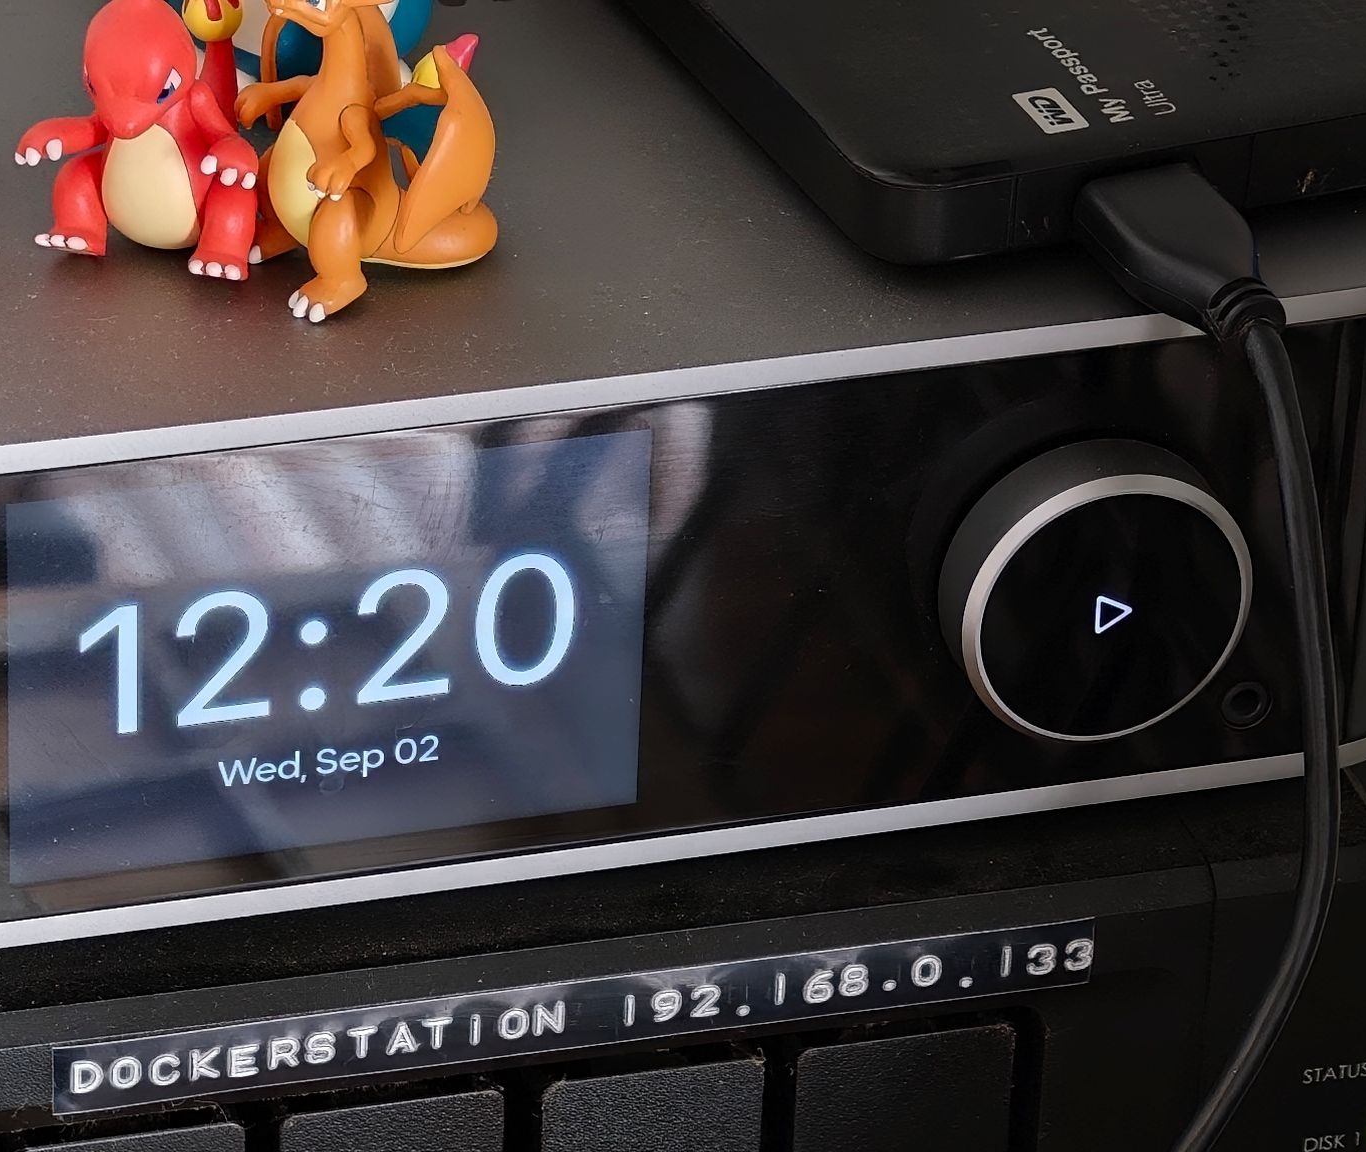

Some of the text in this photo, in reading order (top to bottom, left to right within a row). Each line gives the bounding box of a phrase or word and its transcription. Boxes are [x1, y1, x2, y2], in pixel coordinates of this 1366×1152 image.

[1027, 27, 1134, 123] My Passport
[1134, 79, 1176, 116] Ultra
[79, 553, 575, 734] 12:20
[218, 734, 440, 787] Wed, Sep 02
[623, 938, 1095, 1027] 192.168.0.133
[1304, 1133, 1345, 1152] DISK
